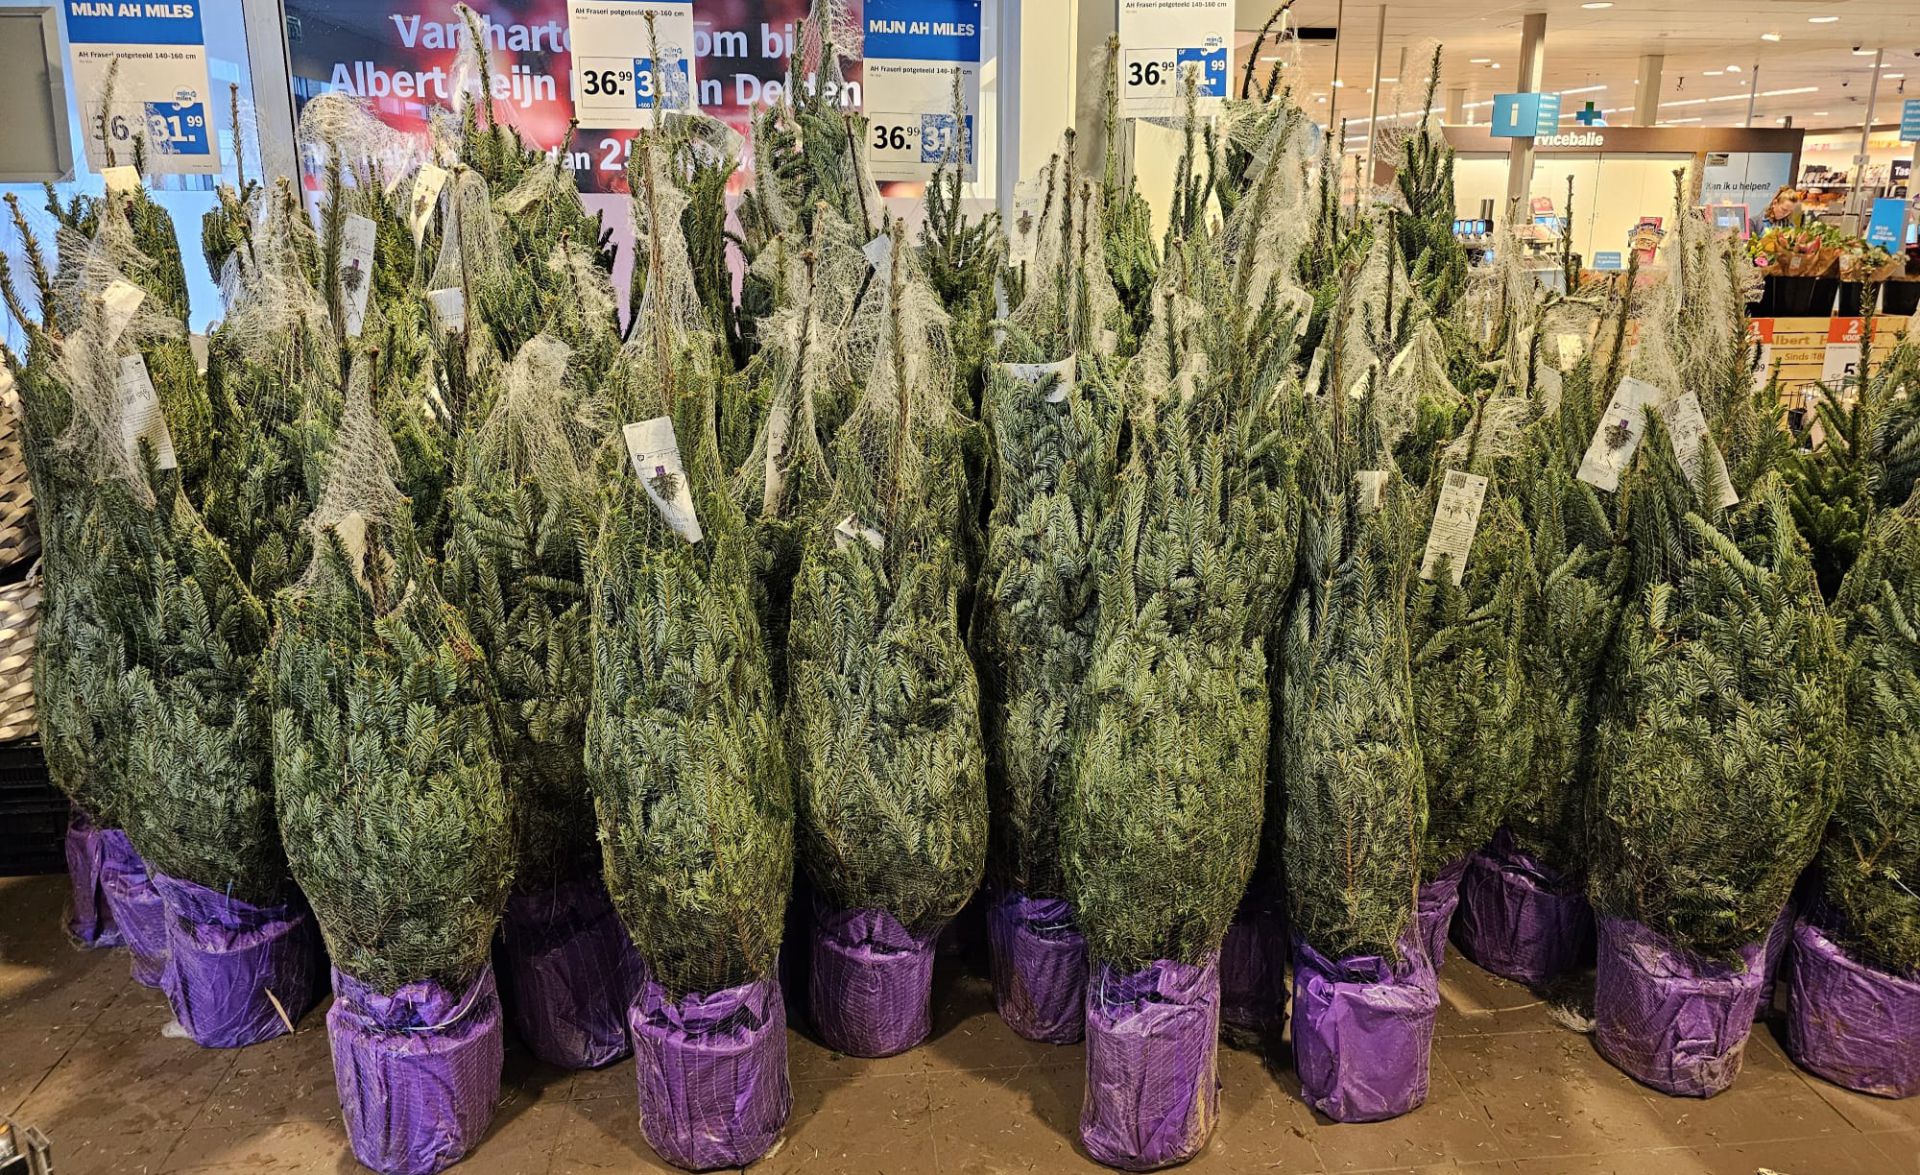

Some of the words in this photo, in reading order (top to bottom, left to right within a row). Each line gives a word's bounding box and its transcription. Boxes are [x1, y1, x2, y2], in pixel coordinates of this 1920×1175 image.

[71, 2, 115, 17] MIJN
[118, 3, 142, 18] AH
[145, 4, 195, 19] MILES
[393, 14, 462, 49] Van
[485, 14, 571, 52] hart
[760, 23, 794, 59] bi
[869, 20, 906, 34] MIJN
[909, 21, 930, 35] AH
[933, 22, 976, 37] MILES
[78, 51, 89, 59] AH
[155, 52, 184, 60] 140-160
[1128, 62, 1175, 86] 36.99
[329, 61, 448, 98] Albert
[487, 65, 556, 108] eijn
[583, 70, 633, 96] 36.99
[873, 125, 920, 150] 36.99
[923, 127, 971, 152] 31.9
[1739, 181, 1771, 192] helpen?
[1847, 320, 1859, 334] 2
[1772, 335, 1811, 345] lbert
[1784, 353, 1809, 361] Sinds
